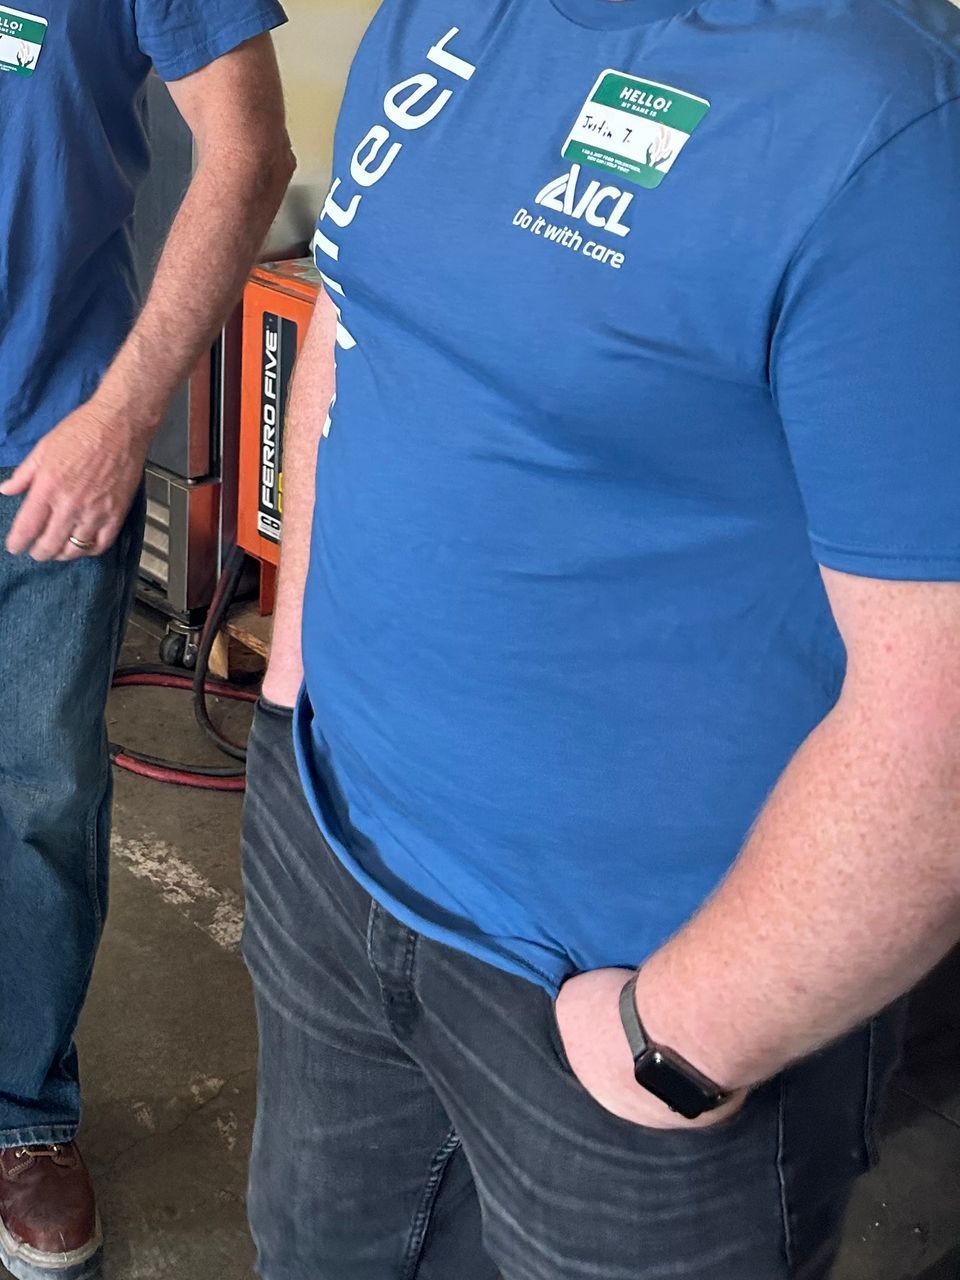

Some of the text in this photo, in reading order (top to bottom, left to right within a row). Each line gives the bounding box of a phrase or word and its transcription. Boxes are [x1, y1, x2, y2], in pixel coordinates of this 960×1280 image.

[619, 86, 673, 113] HELLO!
[512, 208, 626, 269] Do it with care
[263, 329, 279, 399] FIVE
[261, 404, 277, 510] FERRO
